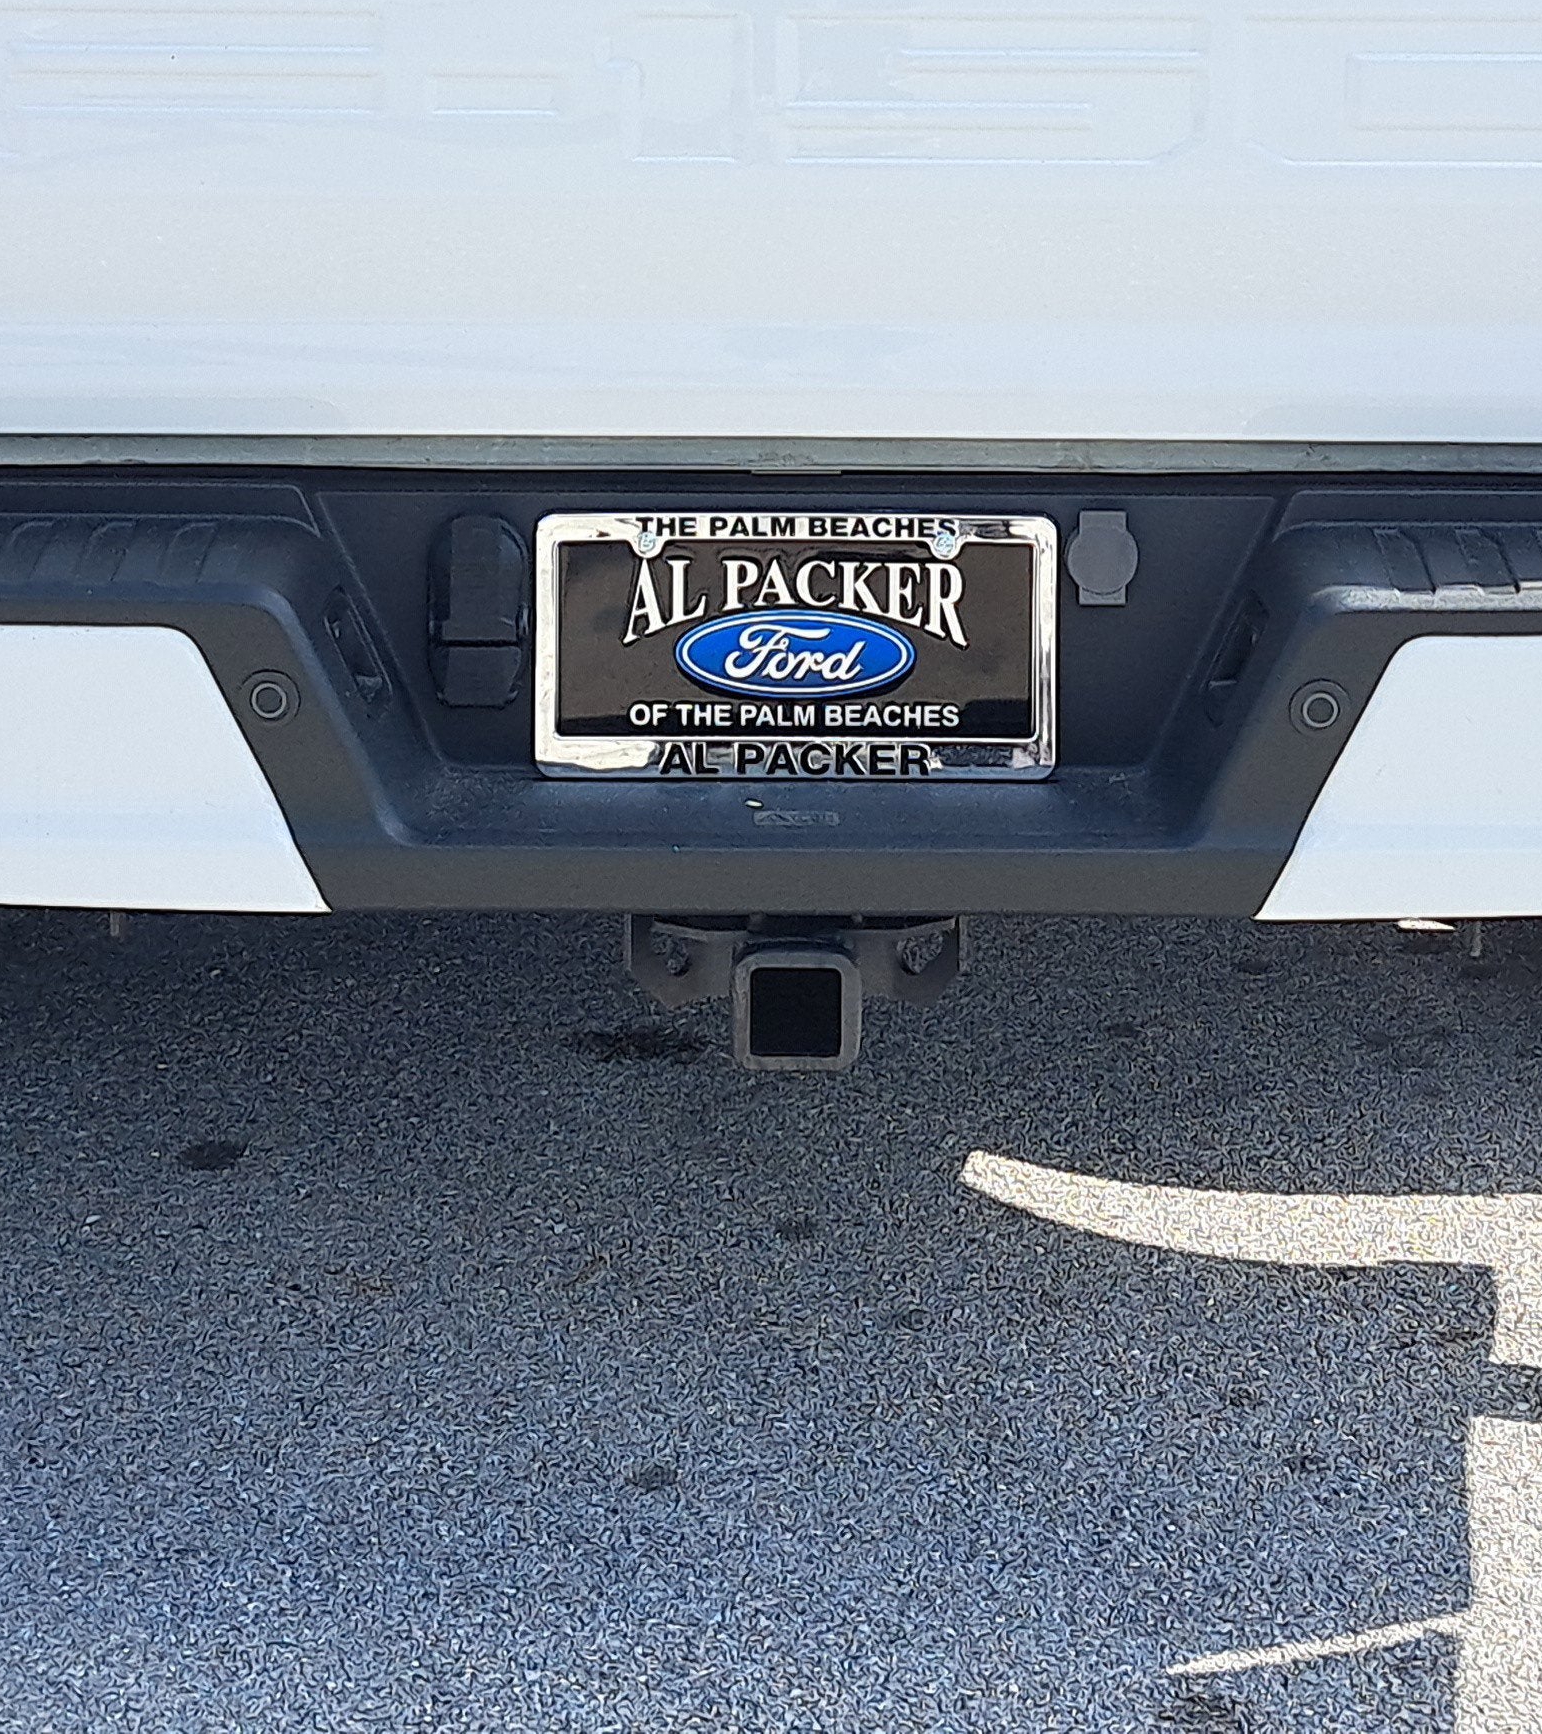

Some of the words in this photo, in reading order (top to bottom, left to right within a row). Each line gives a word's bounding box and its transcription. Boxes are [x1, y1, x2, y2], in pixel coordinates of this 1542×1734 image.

[637, 516, 697, 537] THE
[709, 516, 796, 537] PALM
[809, 517, 958, 537] BEACHES
[622, 558, 707, 646] AL
[721, 559, 969, 648] PACKER
[723, 623, 867, 682] Ford
[629, 703, 670, 728] OF
[676, 704, 732, 727] THE
[740, 704, 815, 727] PALM
[824, 704, 960, 728] BEACHES
[658, 742, 721, 776] AL
[735, 742, 931, 776] PACKER
